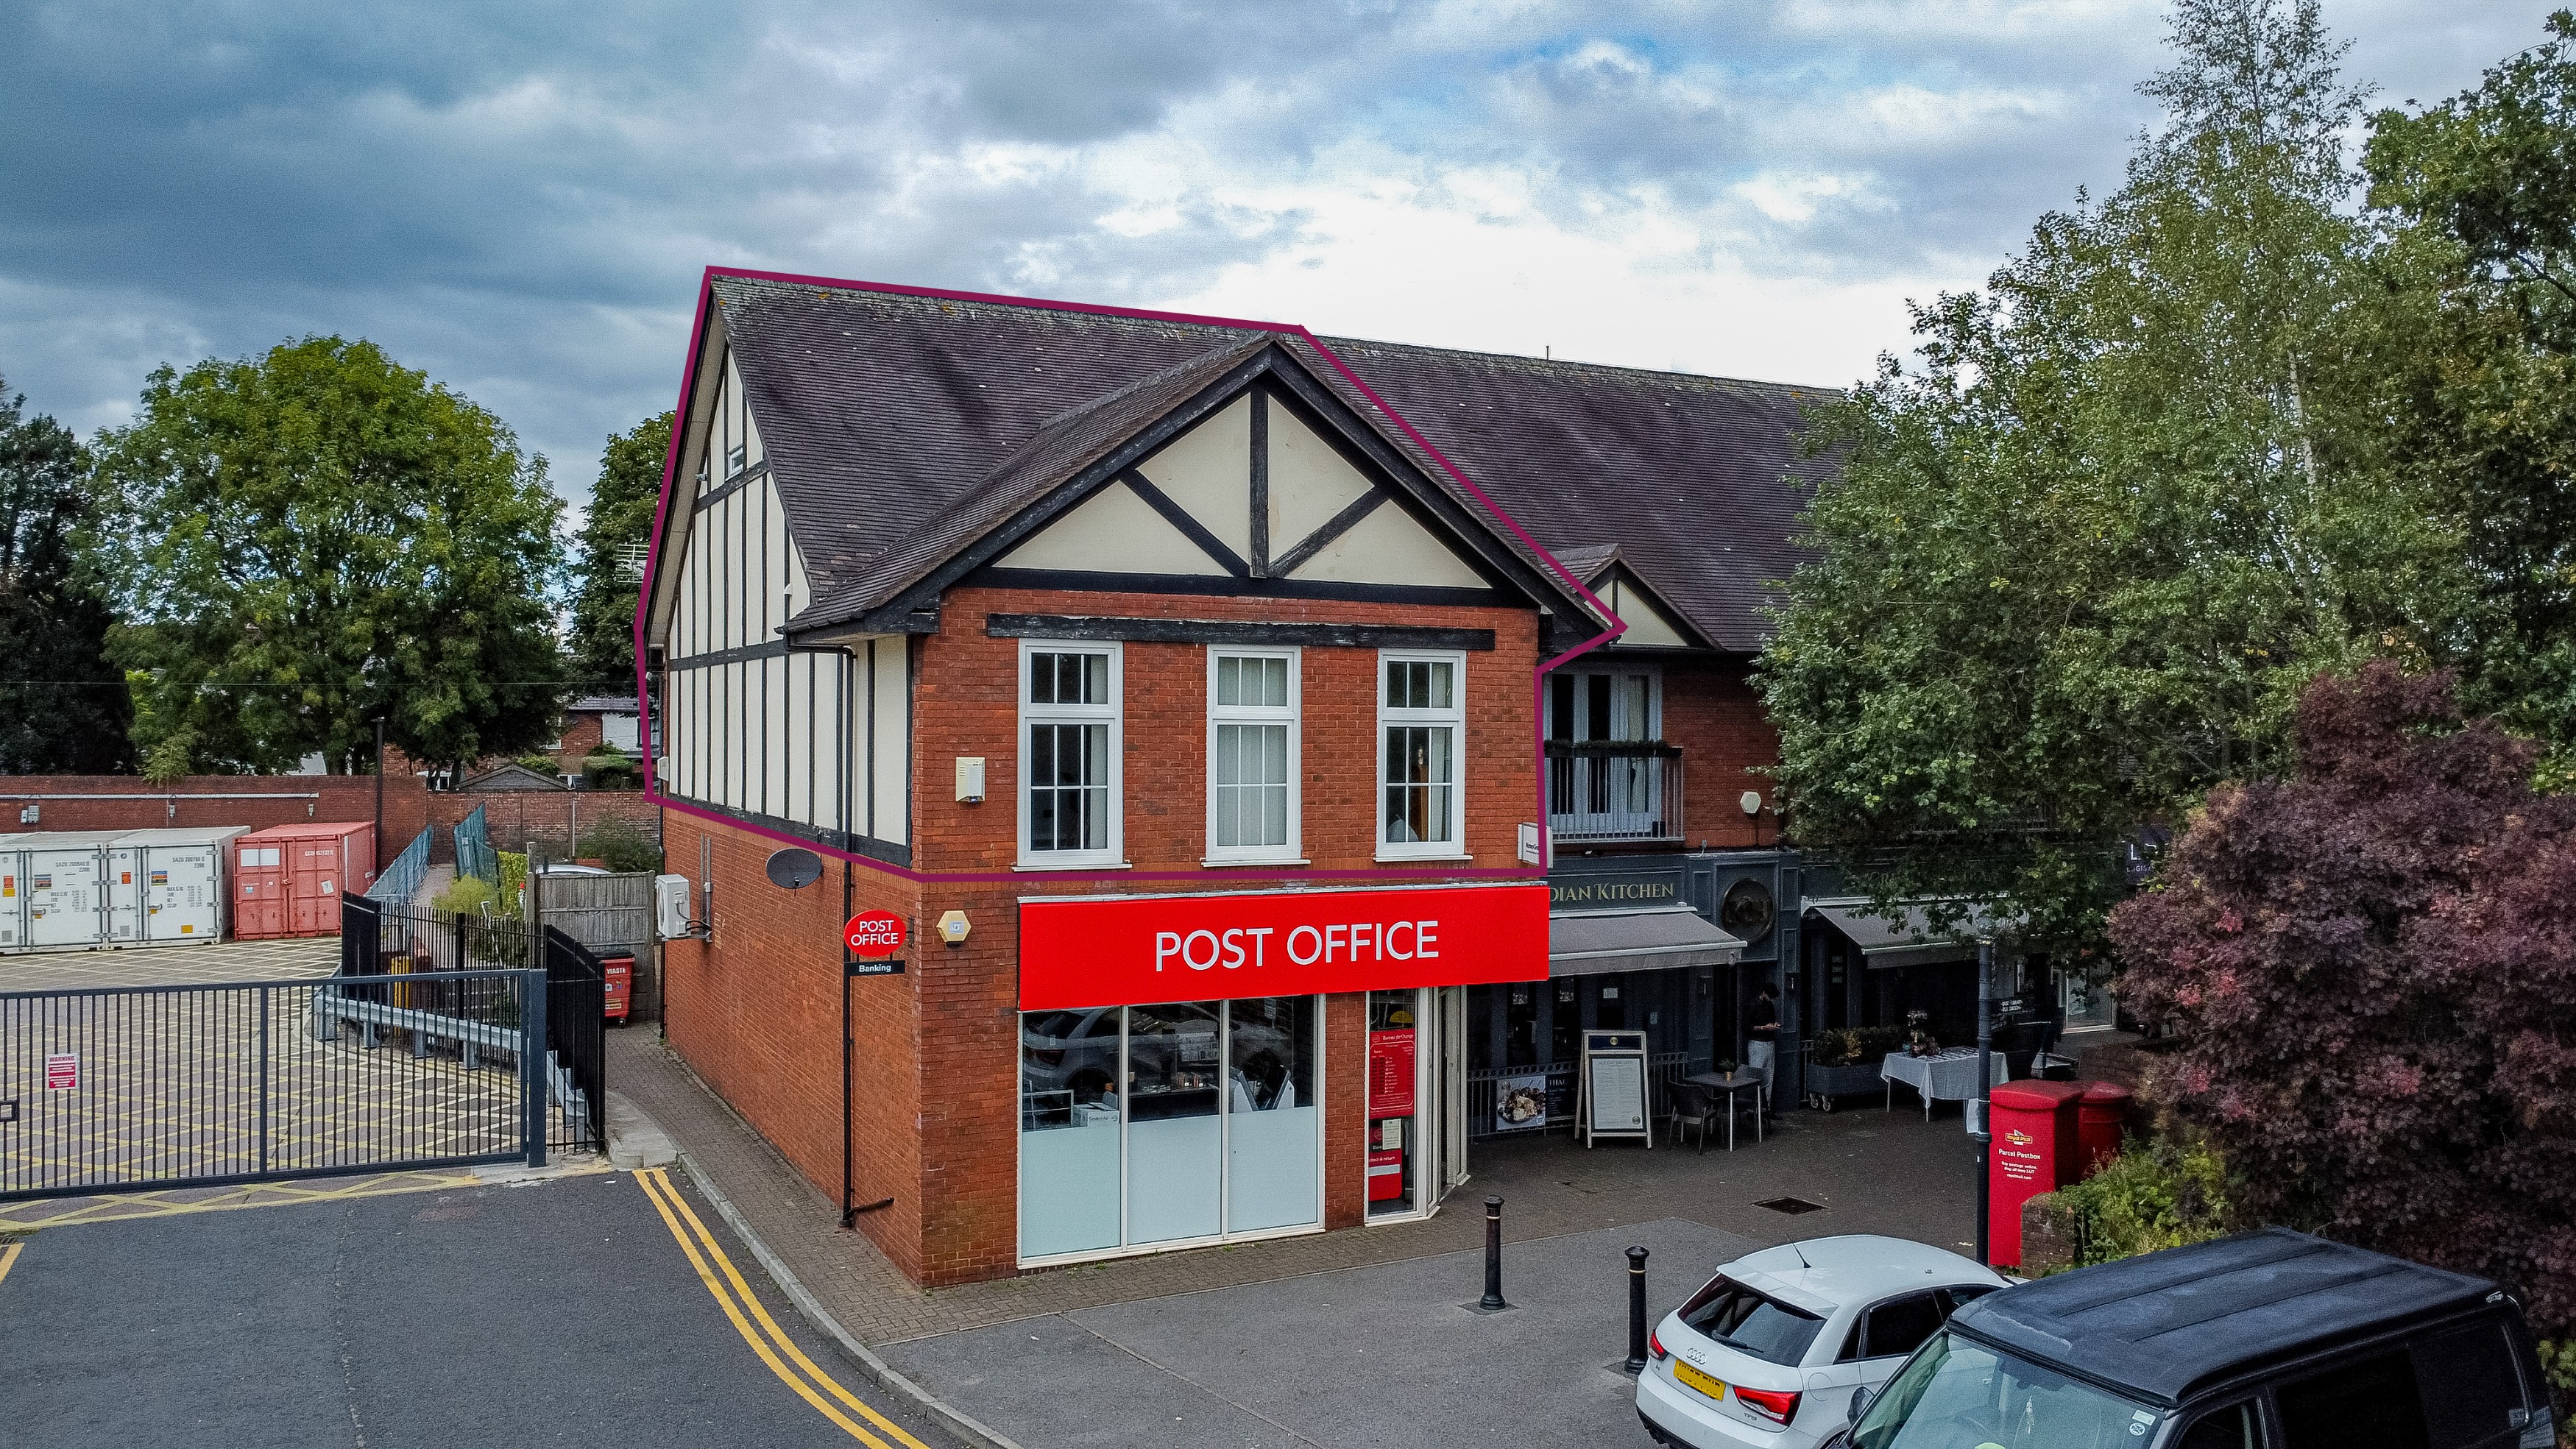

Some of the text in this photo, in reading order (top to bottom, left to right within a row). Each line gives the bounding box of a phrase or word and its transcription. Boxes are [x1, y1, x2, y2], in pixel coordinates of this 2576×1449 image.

[859, 920, 894, 932] POST
[851, 933, 899, 946] OFFICE
[1156, 920, 1439, 972] POST OFFICE
[859, 963, 891, 972] Banking
[1998, 1148, 2041, 1160] Parcel Postbox
